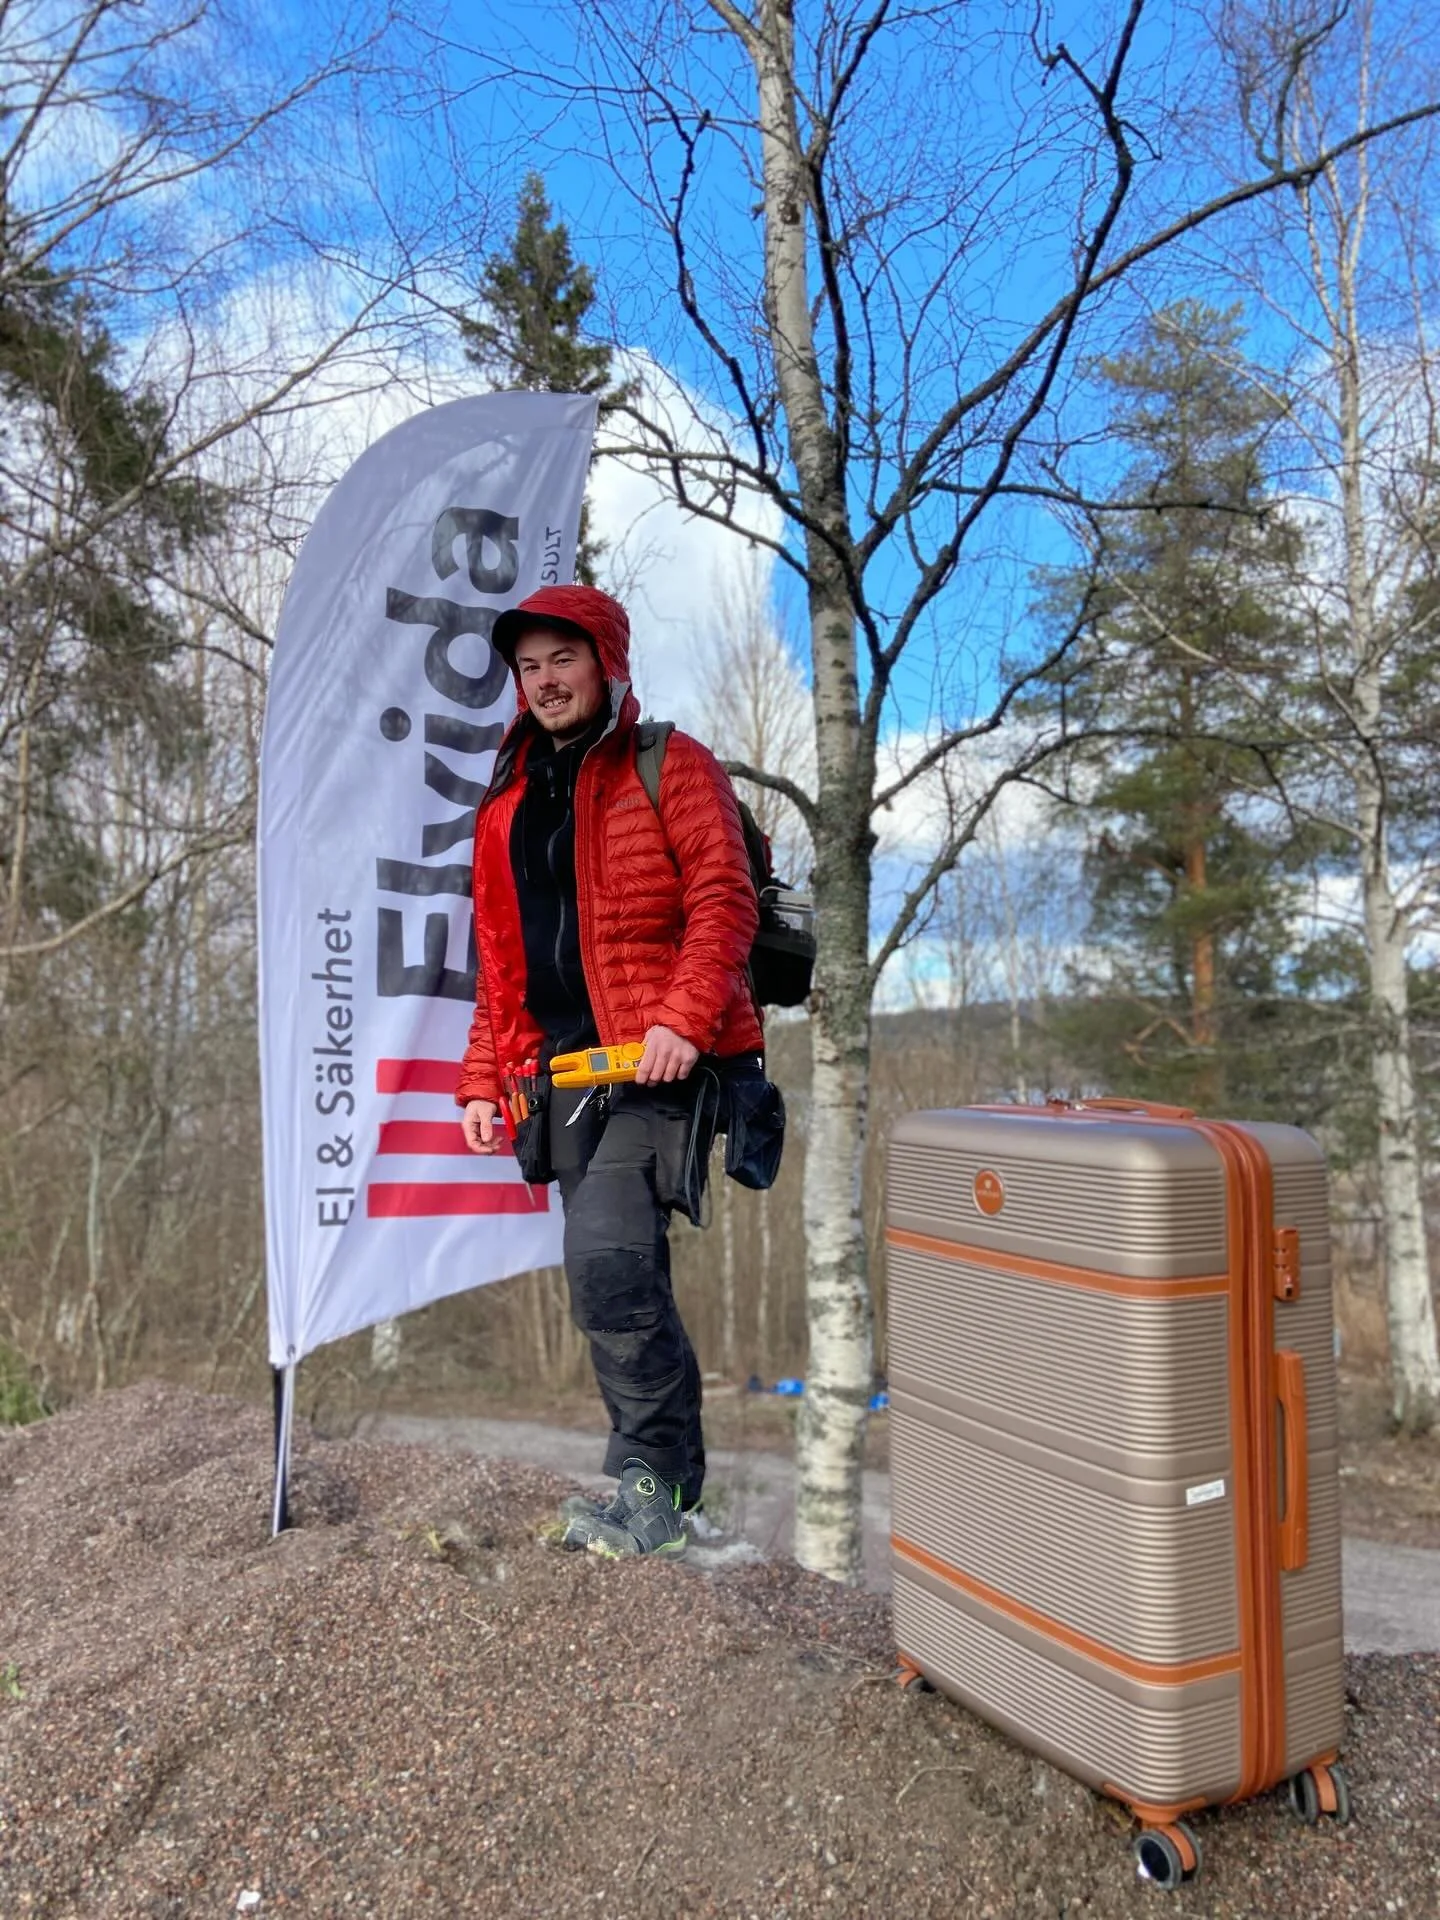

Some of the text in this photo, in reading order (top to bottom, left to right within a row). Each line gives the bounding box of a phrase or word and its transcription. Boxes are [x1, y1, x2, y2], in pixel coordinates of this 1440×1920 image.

[376, 506, 519, 1003] Elvida
[311, 908, 354, 1227] El & Säkerhet
